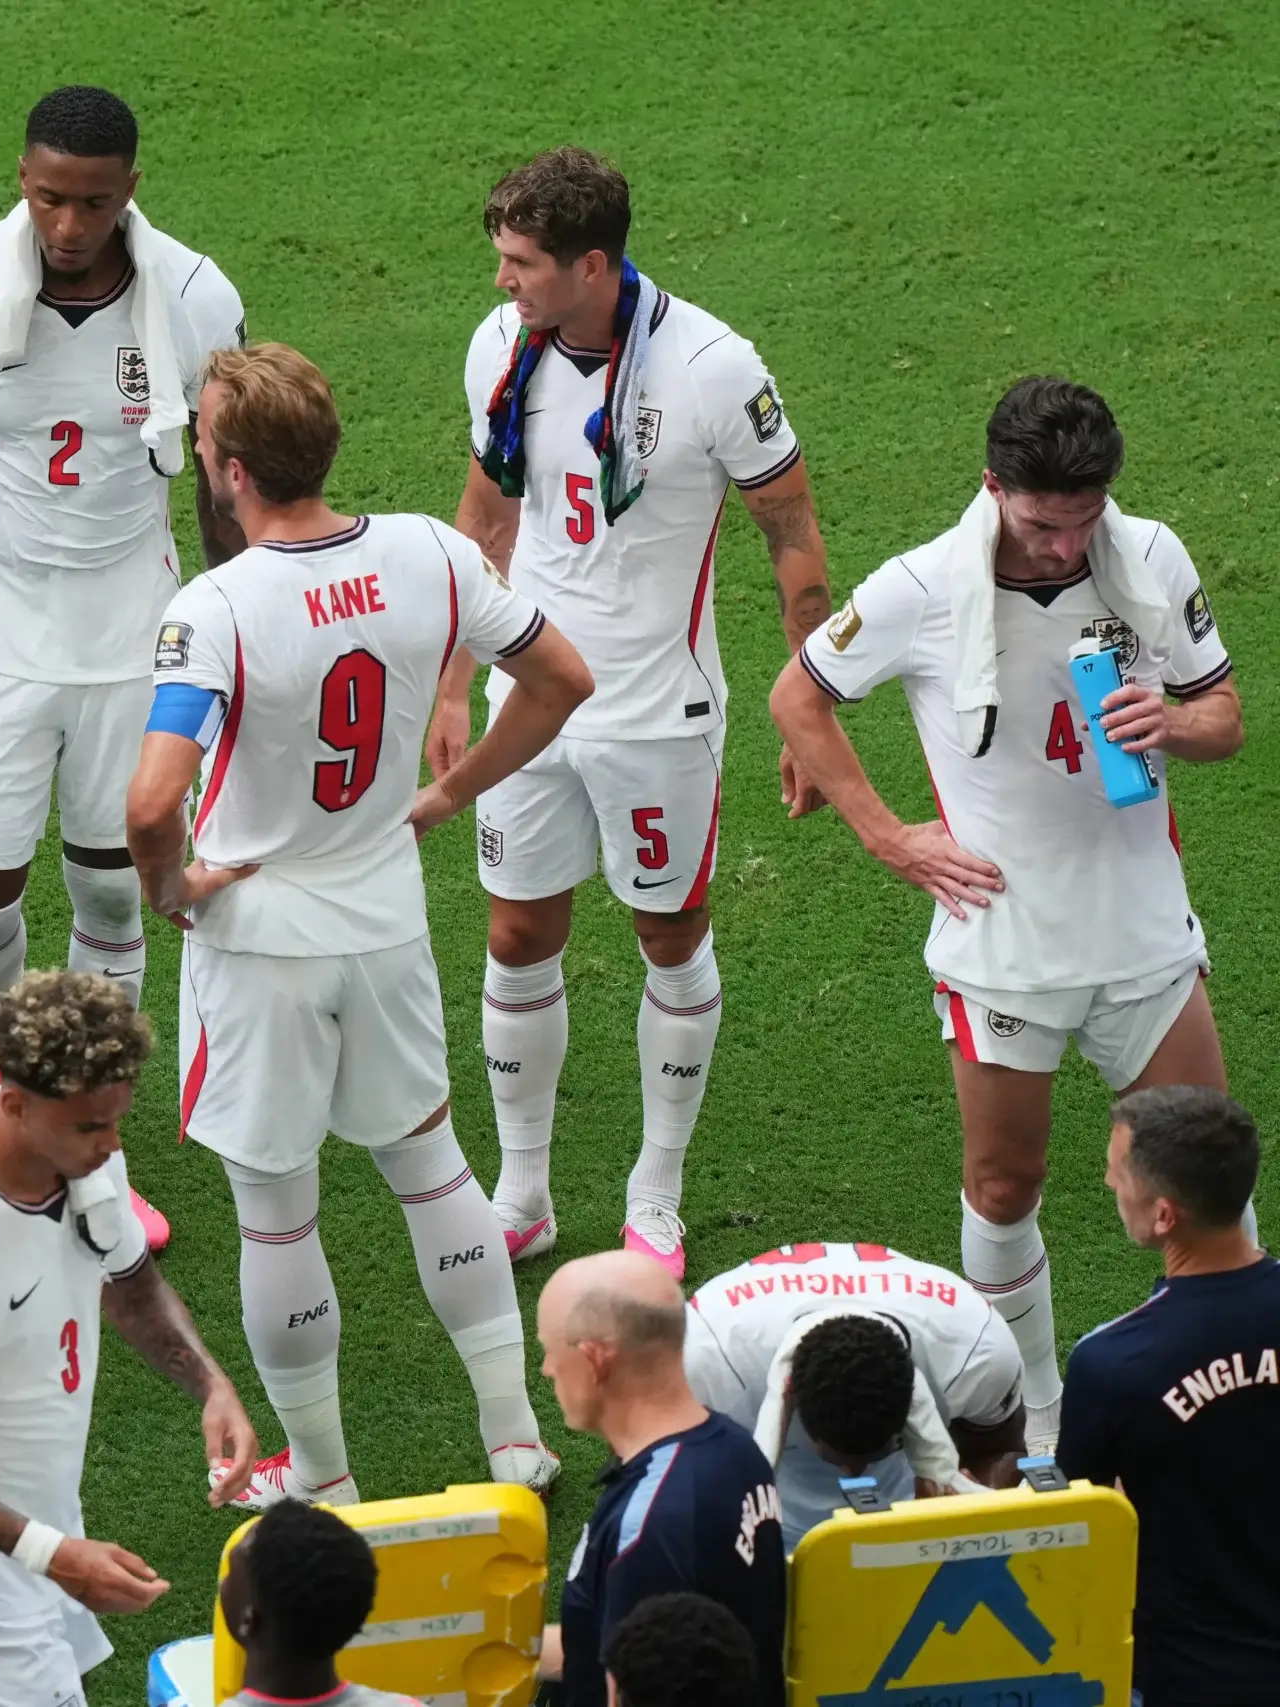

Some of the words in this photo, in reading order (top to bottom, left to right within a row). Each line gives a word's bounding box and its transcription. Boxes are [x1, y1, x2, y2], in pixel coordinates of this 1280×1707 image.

[48, 420, 83, 487] 2
[565, 472, 595, 545] 5
[304, 573, 386, 628] KANE
[1082, 663, 1094, 673] 17
[312, 647, 387, 814] 9
[1045, 700, 1084, 775] 4
[631, 806, 669, 870] 5
[486, 1055, 521, 1074] ENG
[661, 1062, 702, 1078] ENG
[439, 1245, 485, 1271] ENG
[288, 1299, 329, 1329] ENG
[725, 1272, 957, 1307] BELLINGHAM
[60, 1318, 80, 1394] 3
[1162, 1348, 1279, 1422] ENGLA
